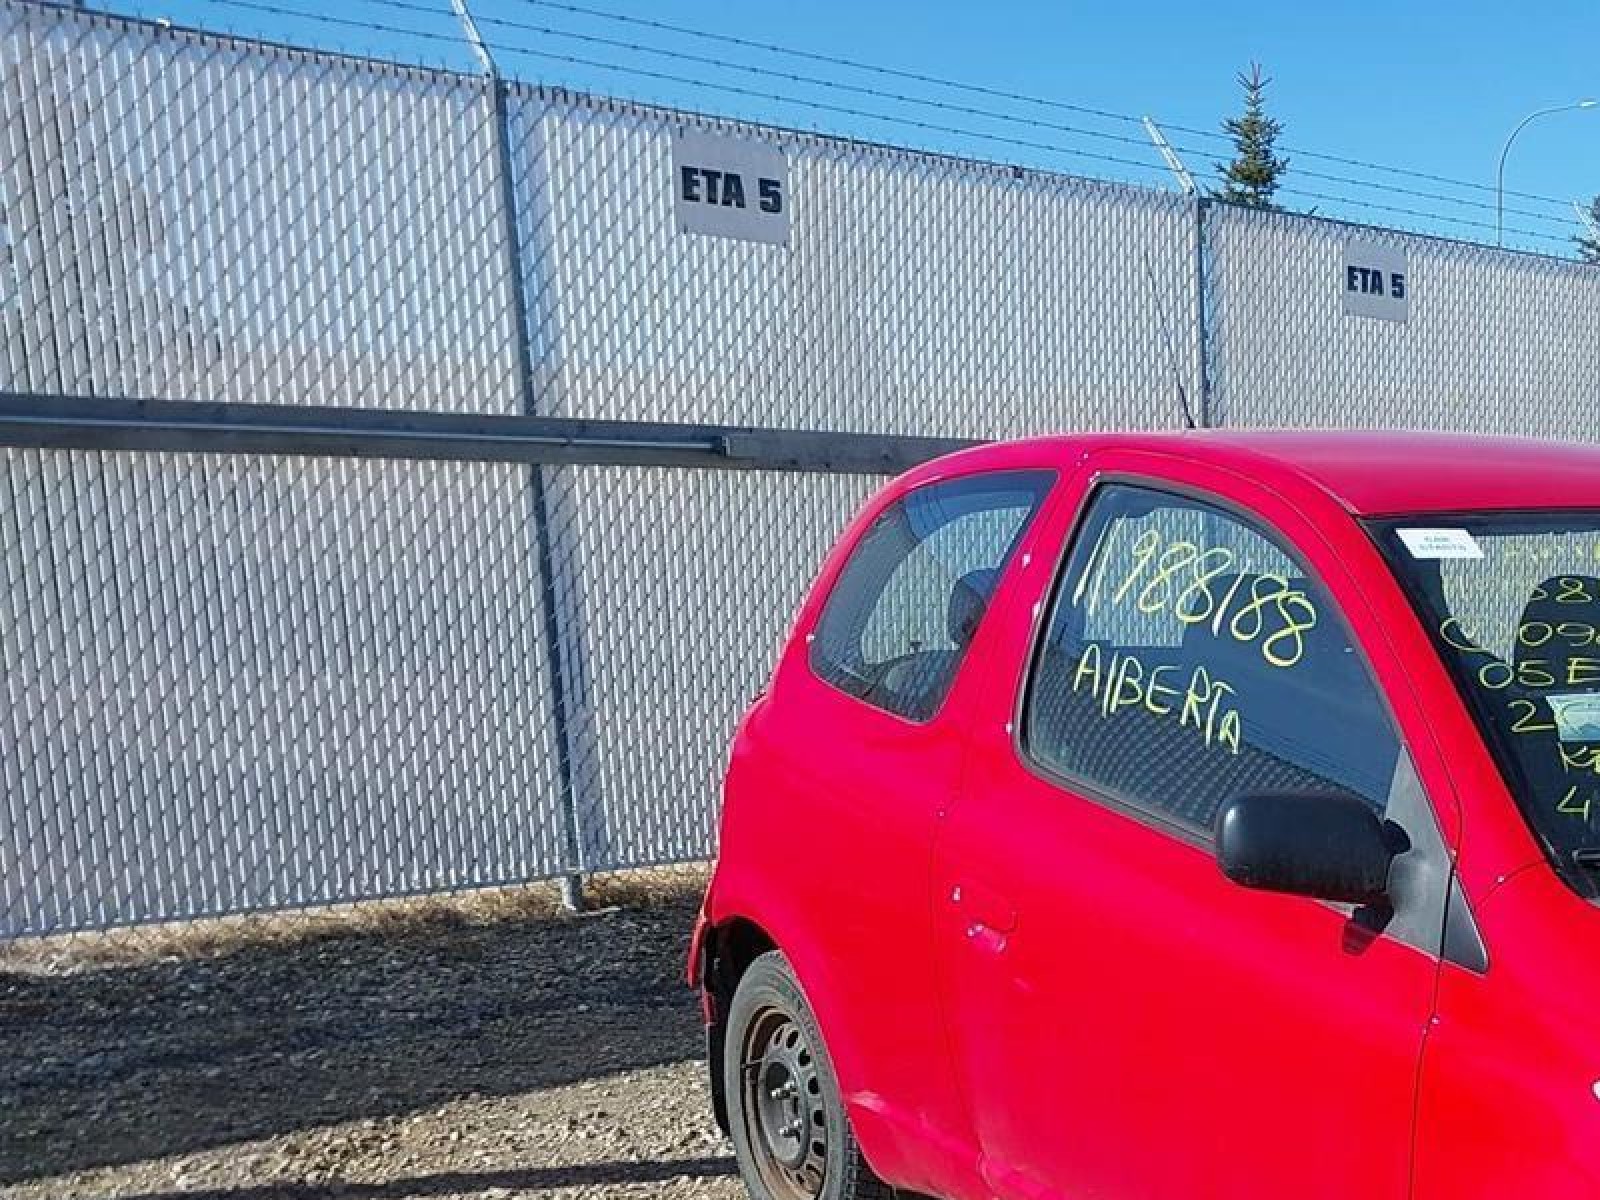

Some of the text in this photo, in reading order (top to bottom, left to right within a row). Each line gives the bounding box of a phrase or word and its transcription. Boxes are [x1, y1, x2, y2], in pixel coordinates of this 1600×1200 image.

[681, 166, 783, 213] ETA 5
[1347, 265, 1405, 299] ETA 5
[1073, 514, 1318, 668] 11988188
